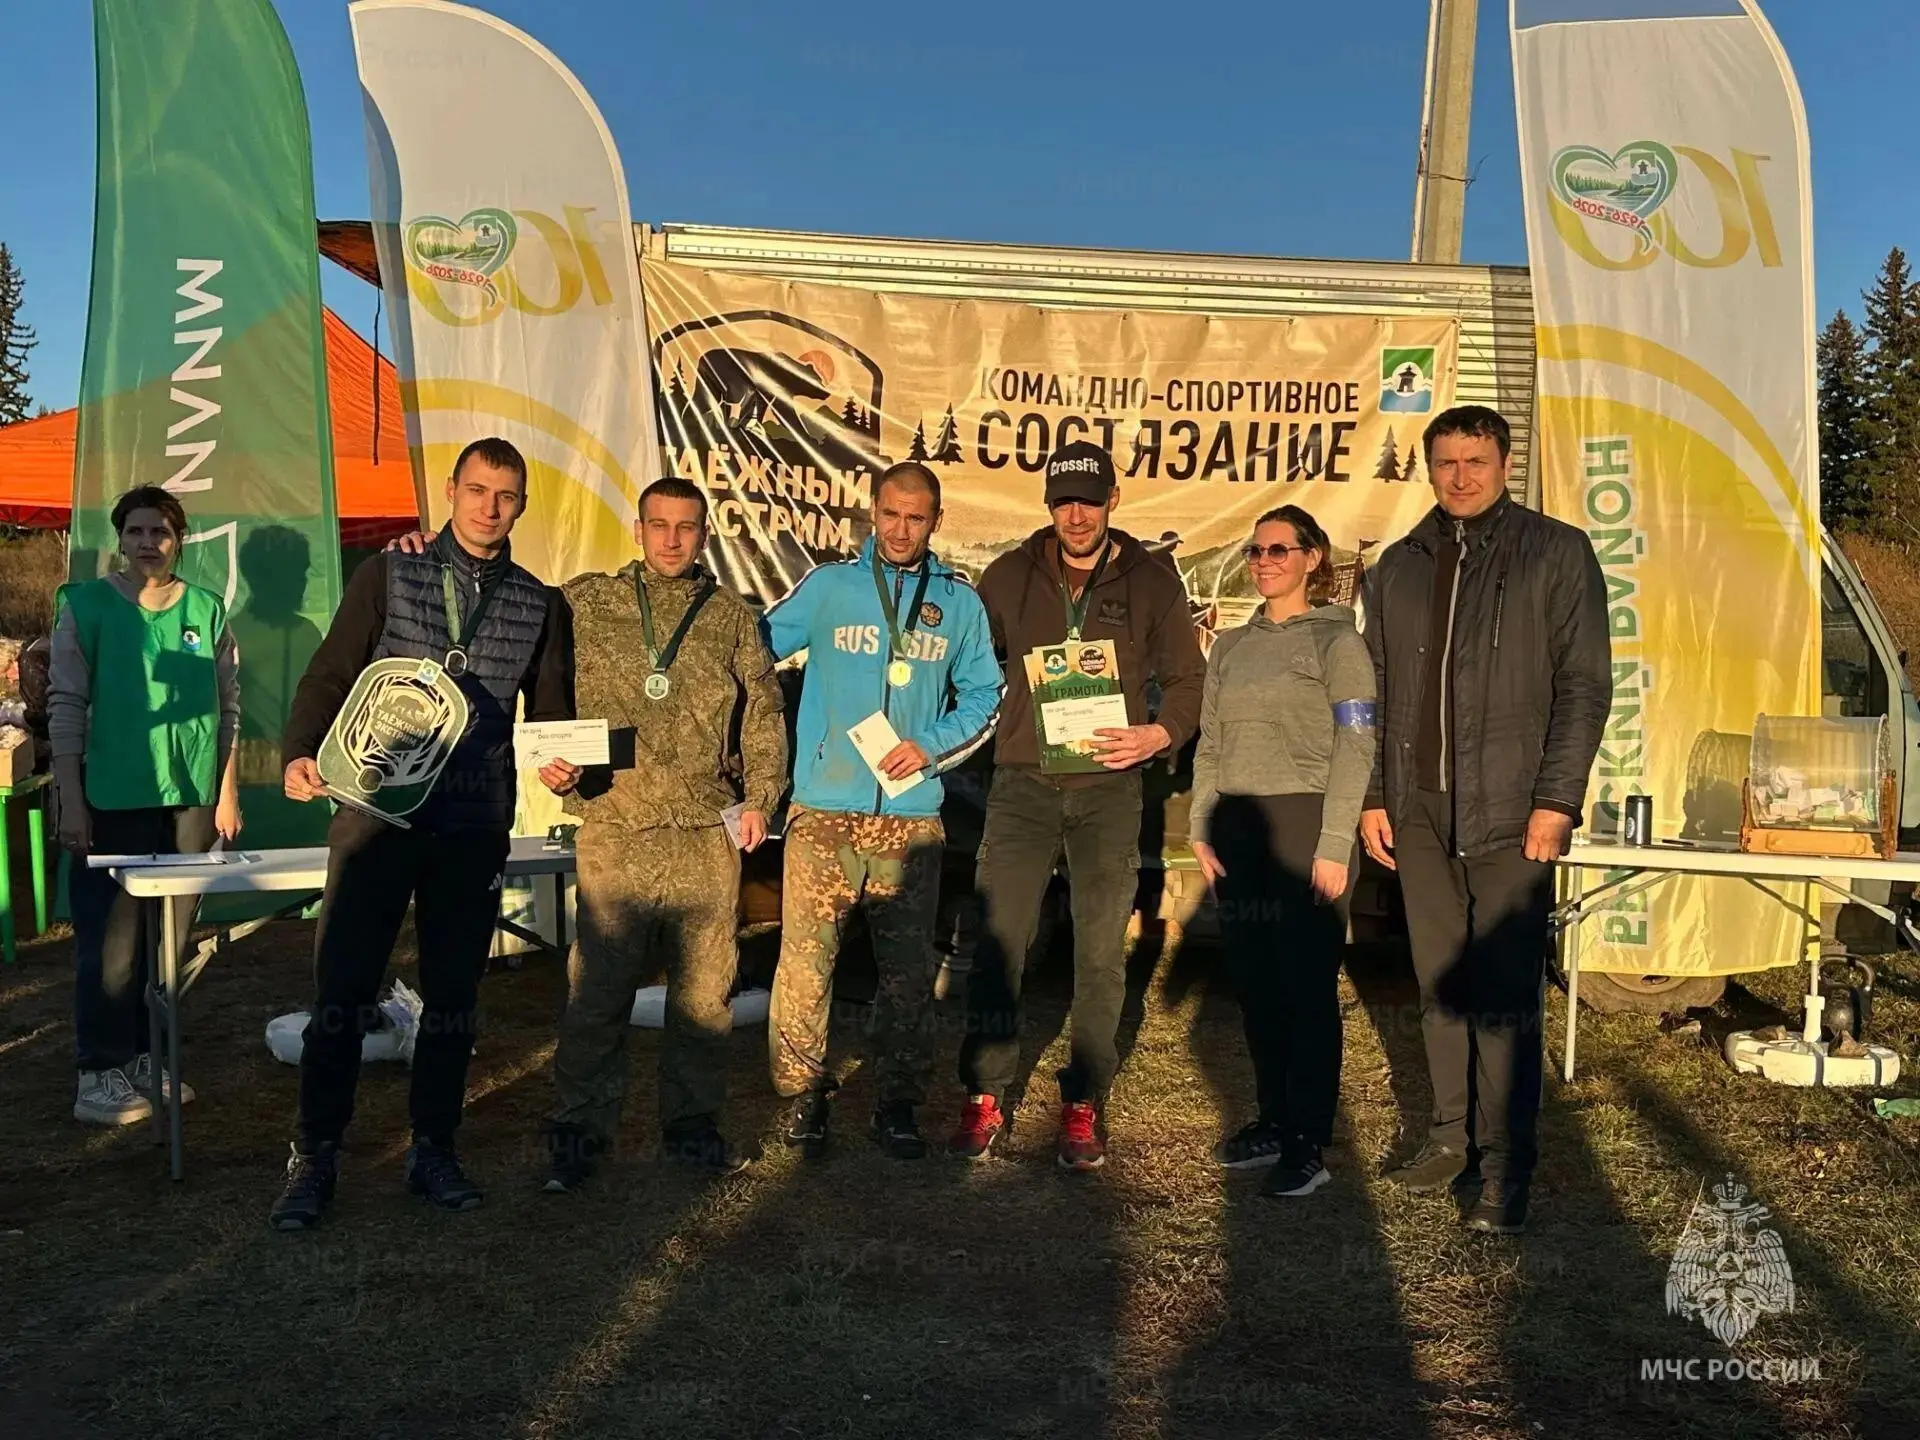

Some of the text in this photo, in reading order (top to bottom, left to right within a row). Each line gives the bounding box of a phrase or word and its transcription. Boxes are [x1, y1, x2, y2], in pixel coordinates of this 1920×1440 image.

[980, 367, 1359, 414] КОМАНДНО-СПОРТИВНОЕ
[1050, 457, 1100, 477] CrossFit
[1055, 684, 1105, 698] ГРАМОТА
